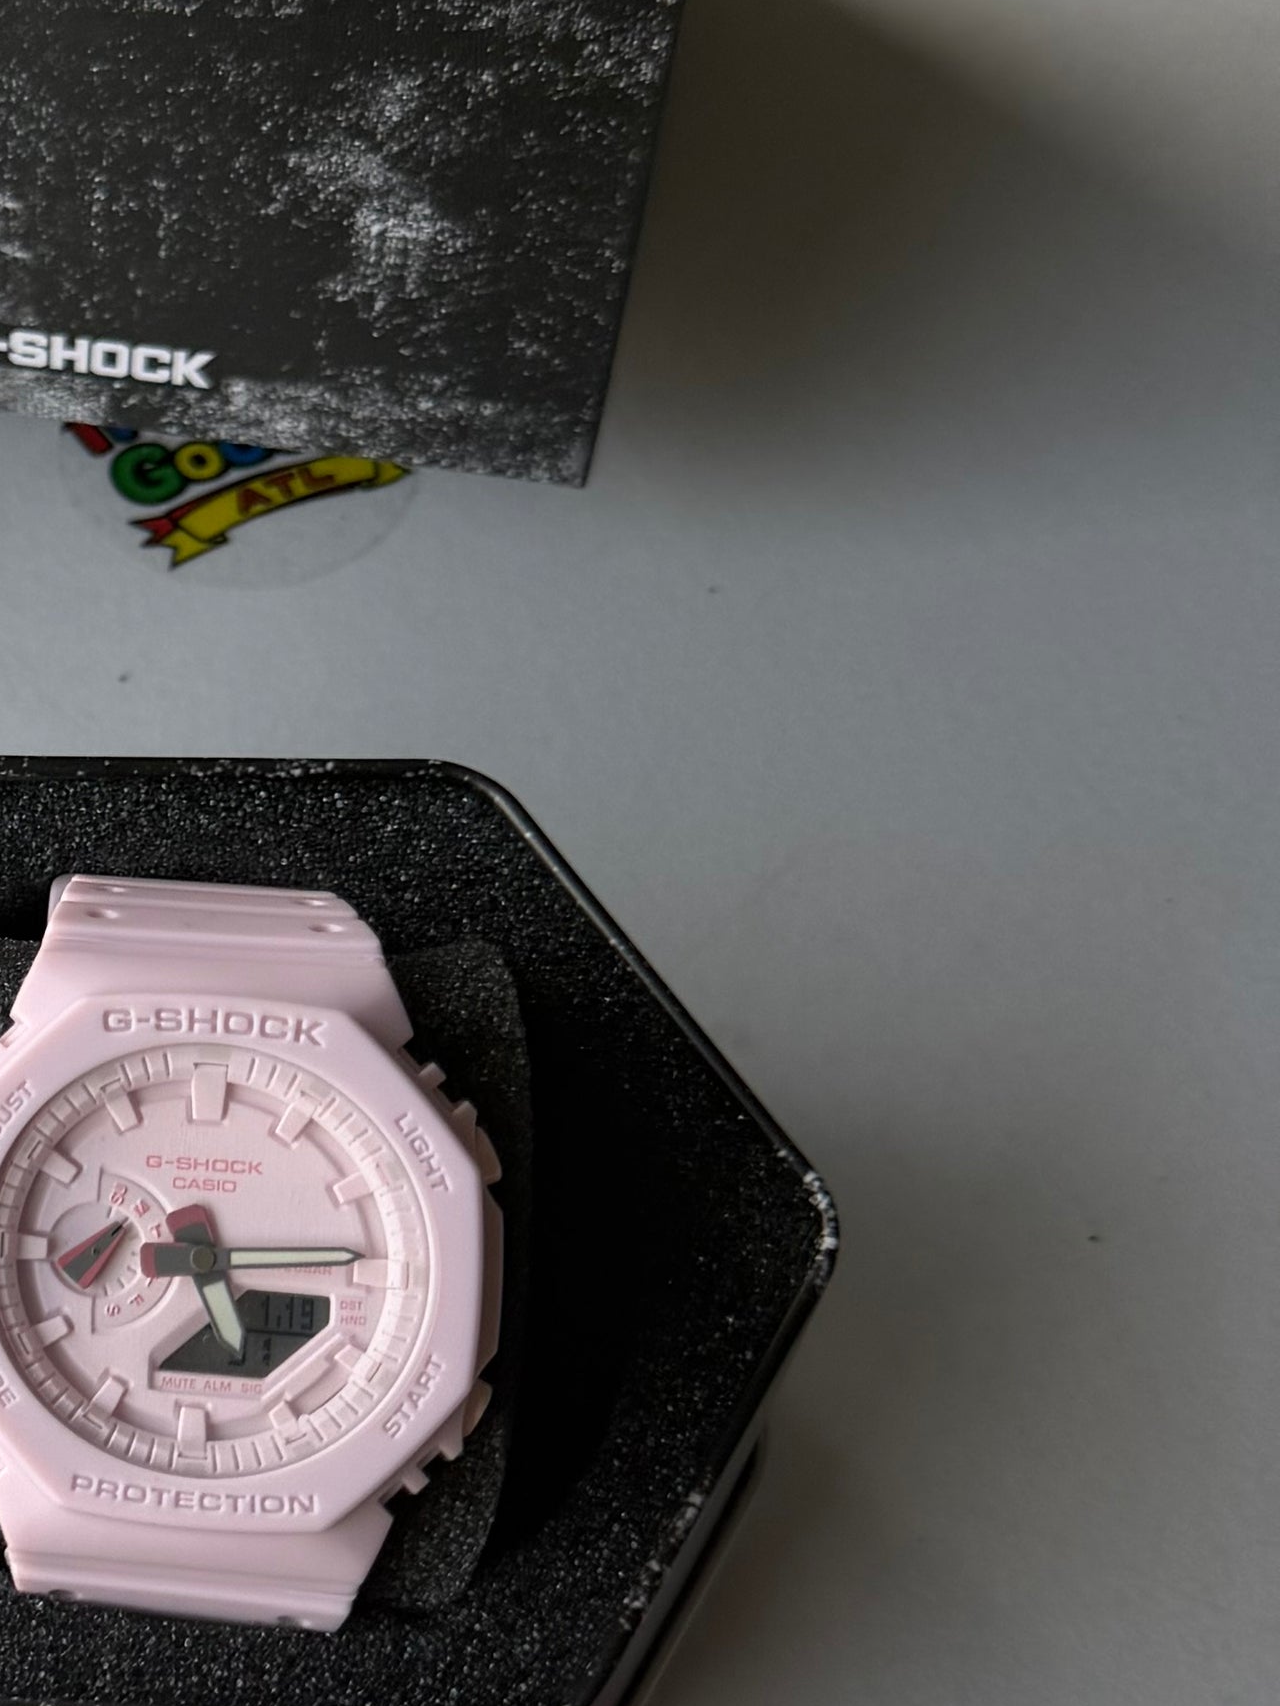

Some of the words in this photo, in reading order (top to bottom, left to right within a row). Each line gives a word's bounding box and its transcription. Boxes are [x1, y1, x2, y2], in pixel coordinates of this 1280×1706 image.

[236, 467, 335, 518] ATL
[101, 1007, 328, 1047] G-SHOCK
[145, 1154, 264, 1175] G-SHOCK
[393, 1111, 449, 1194] LIGHT
[172, 1176, 238, 1193] CASIO
[340, 1299, 364, 1312] DST
[340, 1315, 367, 1327] HND
[160, 1374, 197, 1391] MUTE
[202, 1378, 233, 1393] ALM
[240, 1381, 263, 1394] SIG
[381, 1352, 445, 1440] START
[70, 1473, 320, 1516] PROTECTION
